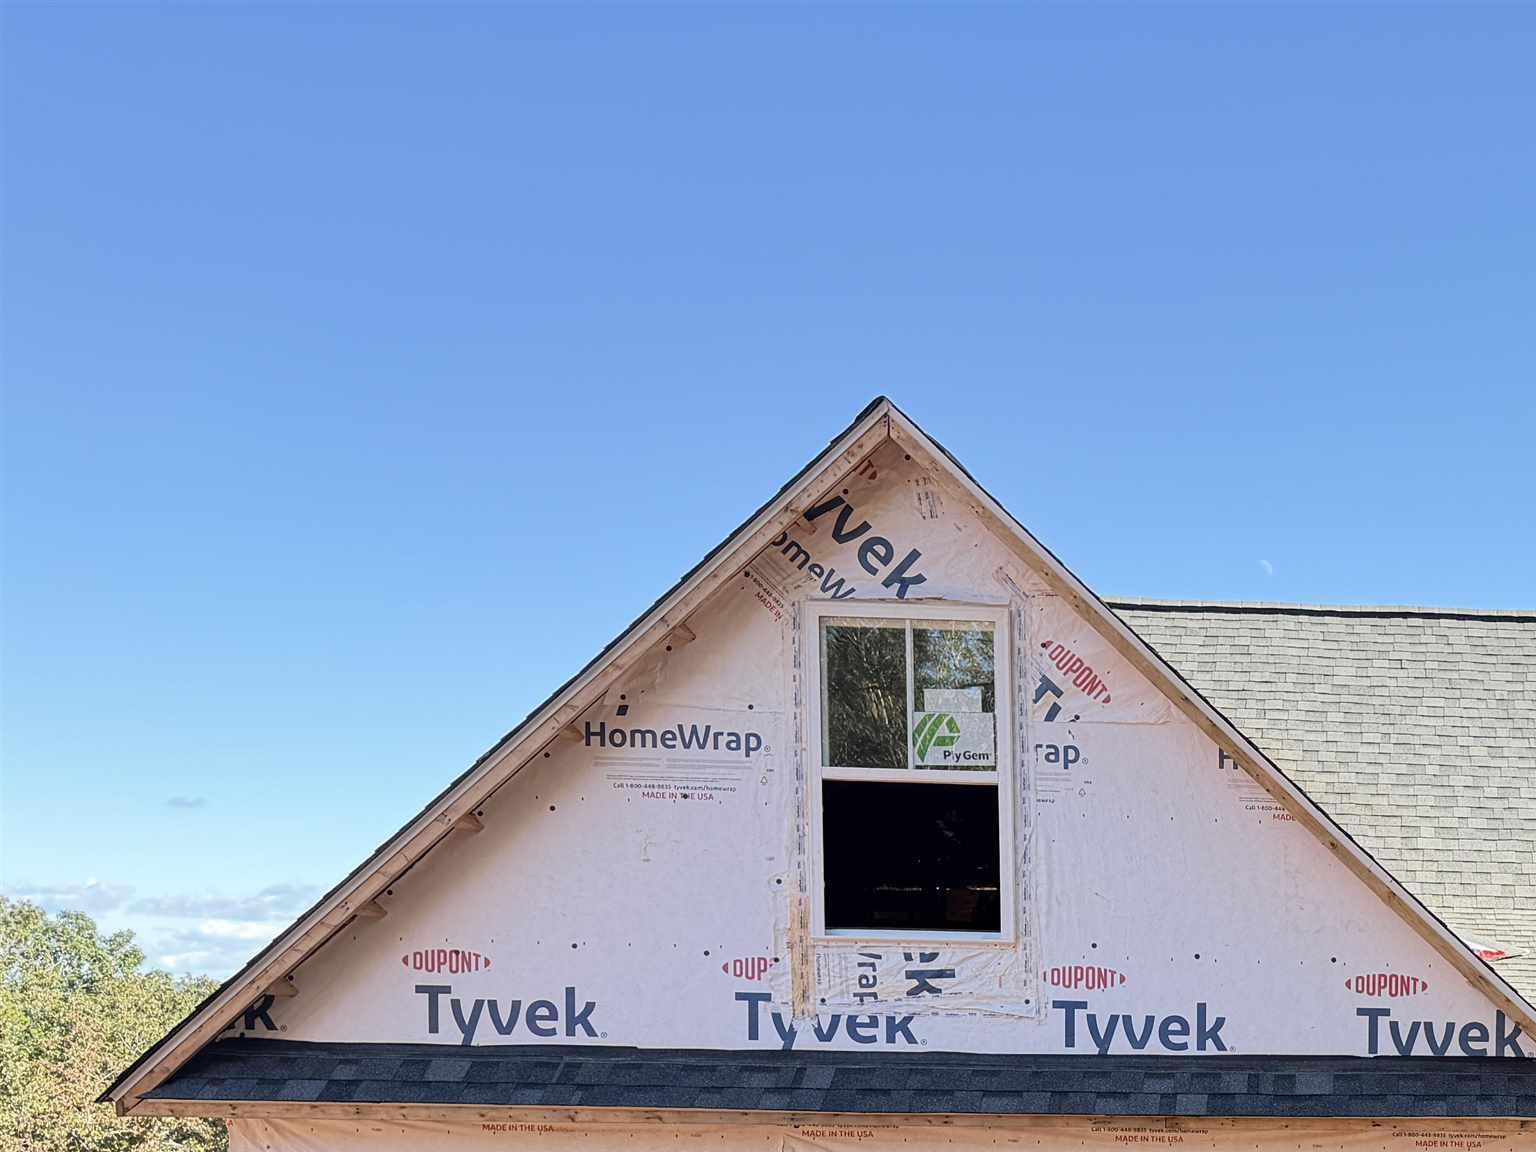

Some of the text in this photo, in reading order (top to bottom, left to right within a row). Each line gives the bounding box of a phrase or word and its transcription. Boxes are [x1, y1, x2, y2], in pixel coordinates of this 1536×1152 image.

[1048, 644, 1110, 701] DUPONT
[584, 721, 763, 758] HomeWrap
[963, 750, 990, 761] Gem
[642, 791, 666, 799] MADE
[668, 792, 678, 800] IN
[697, 793, 714, 801] USA
[412, 948, 482, 974] DUPONT
[1050, 966, 1117, 991] DUPONT
[1355, 973, 1420, 998] DUPONT
[415, 985, 600, 1047] Tyvek
[1052, 1000, 1229, 1054] Tyvek
[1356, 1007, 1528, 1058] Tyvek
[482, 1123, 554, 1133] MADE IN THE USA
[802, 1129, 874, 1139] MADE IN THE USA
[1115, 1135, 1184, 1144] MADE IN THE USA
[1415, 1140, 1439, 1148] MADE
[1440, 1140, 1449, 1148] IN
[1450, 1140, 1466, 1148] THE
